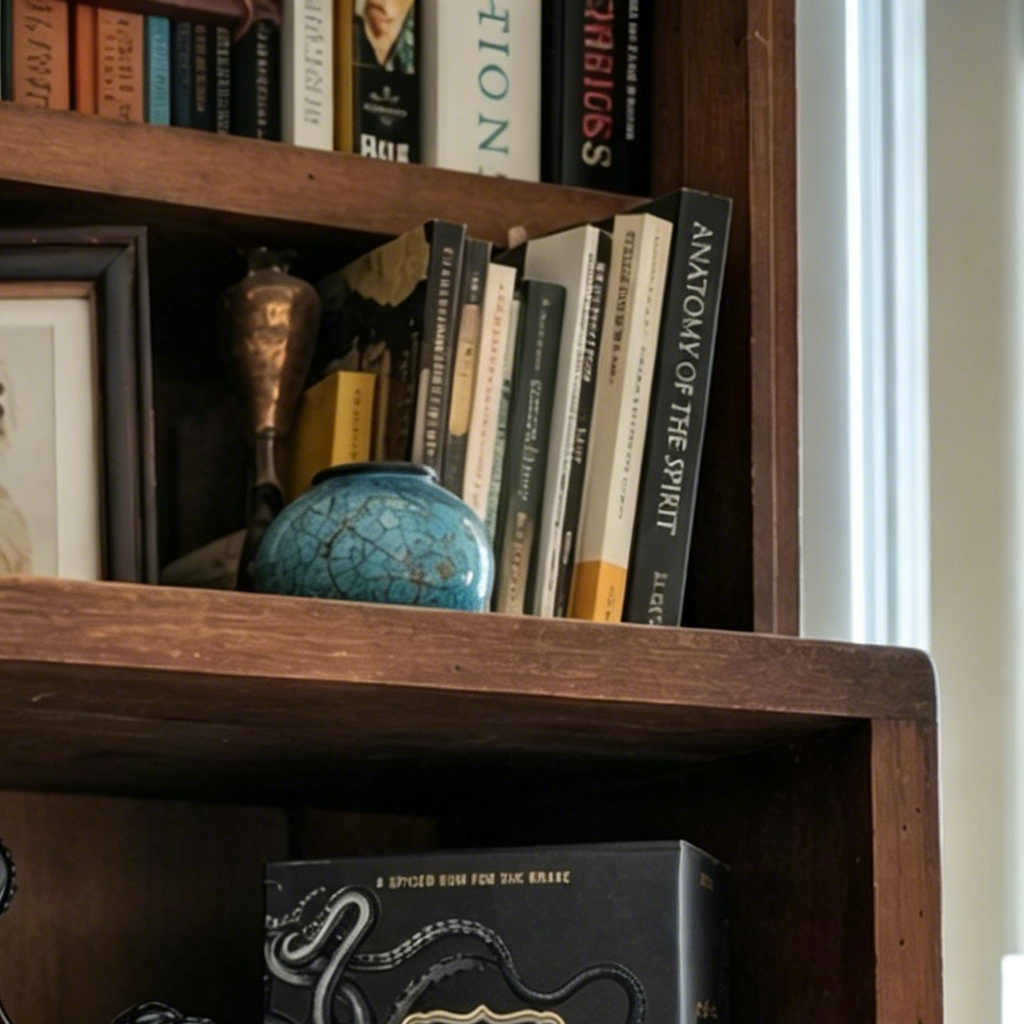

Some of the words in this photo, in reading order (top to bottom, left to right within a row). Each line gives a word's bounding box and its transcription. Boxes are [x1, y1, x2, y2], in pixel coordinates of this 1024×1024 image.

[678, 220, 714, 360] ANATOMY
[673, 361, 697, 396] OF
[667, 402, 692, 452] THE
[656, 454, 685, 537] SPIRIT
